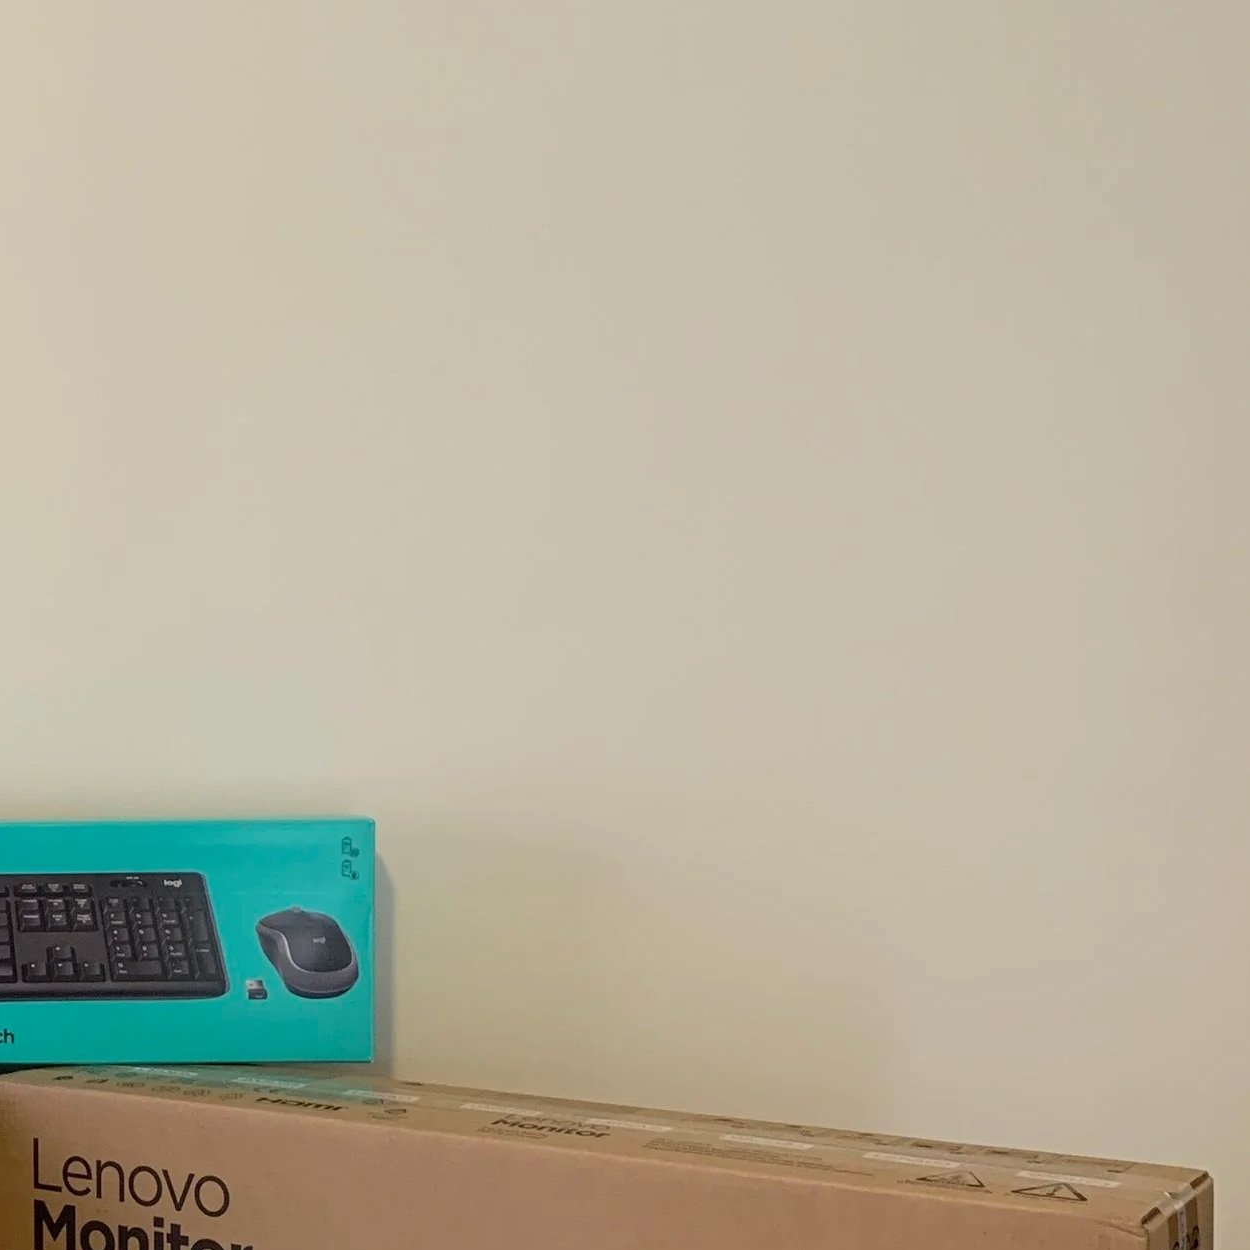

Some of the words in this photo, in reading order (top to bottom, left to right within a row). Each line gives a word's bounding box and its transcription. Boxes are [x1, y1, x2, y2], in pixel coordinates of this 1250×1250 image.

[163, 878, 183, 888] logi
[491, 1119, 612, 1138] Monitor
[33, 1137, 230, 1217] Lenovo
